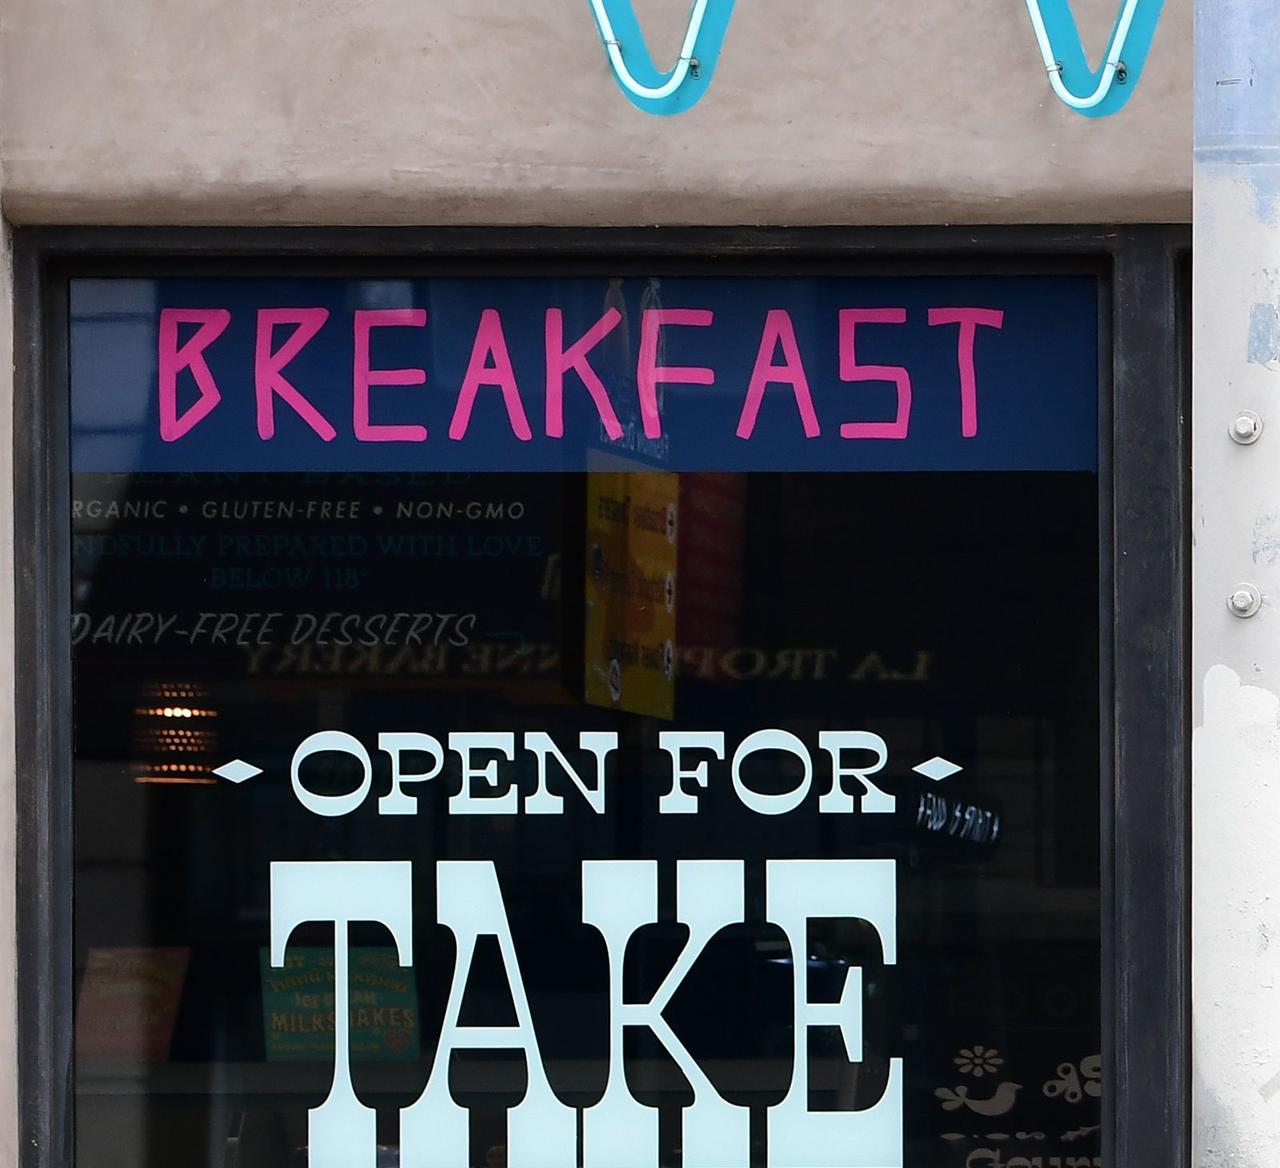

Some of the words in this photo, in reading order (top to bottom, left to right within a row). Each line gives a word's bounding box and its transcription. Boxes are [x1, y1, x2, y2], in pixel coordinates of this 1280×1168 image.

[157, 307, 1004, 442] BREAKFAST
[201, 501, 361, 520] GLUTEN-FREE
[396, 501, 526, 521] NON-GMO
[208, 567, 313, 590] BELOW
[291, 612, 478, 648] DESSERTS
[291, 729, 618, 817] OPEN
[658, 728, 896, 816] FOR
